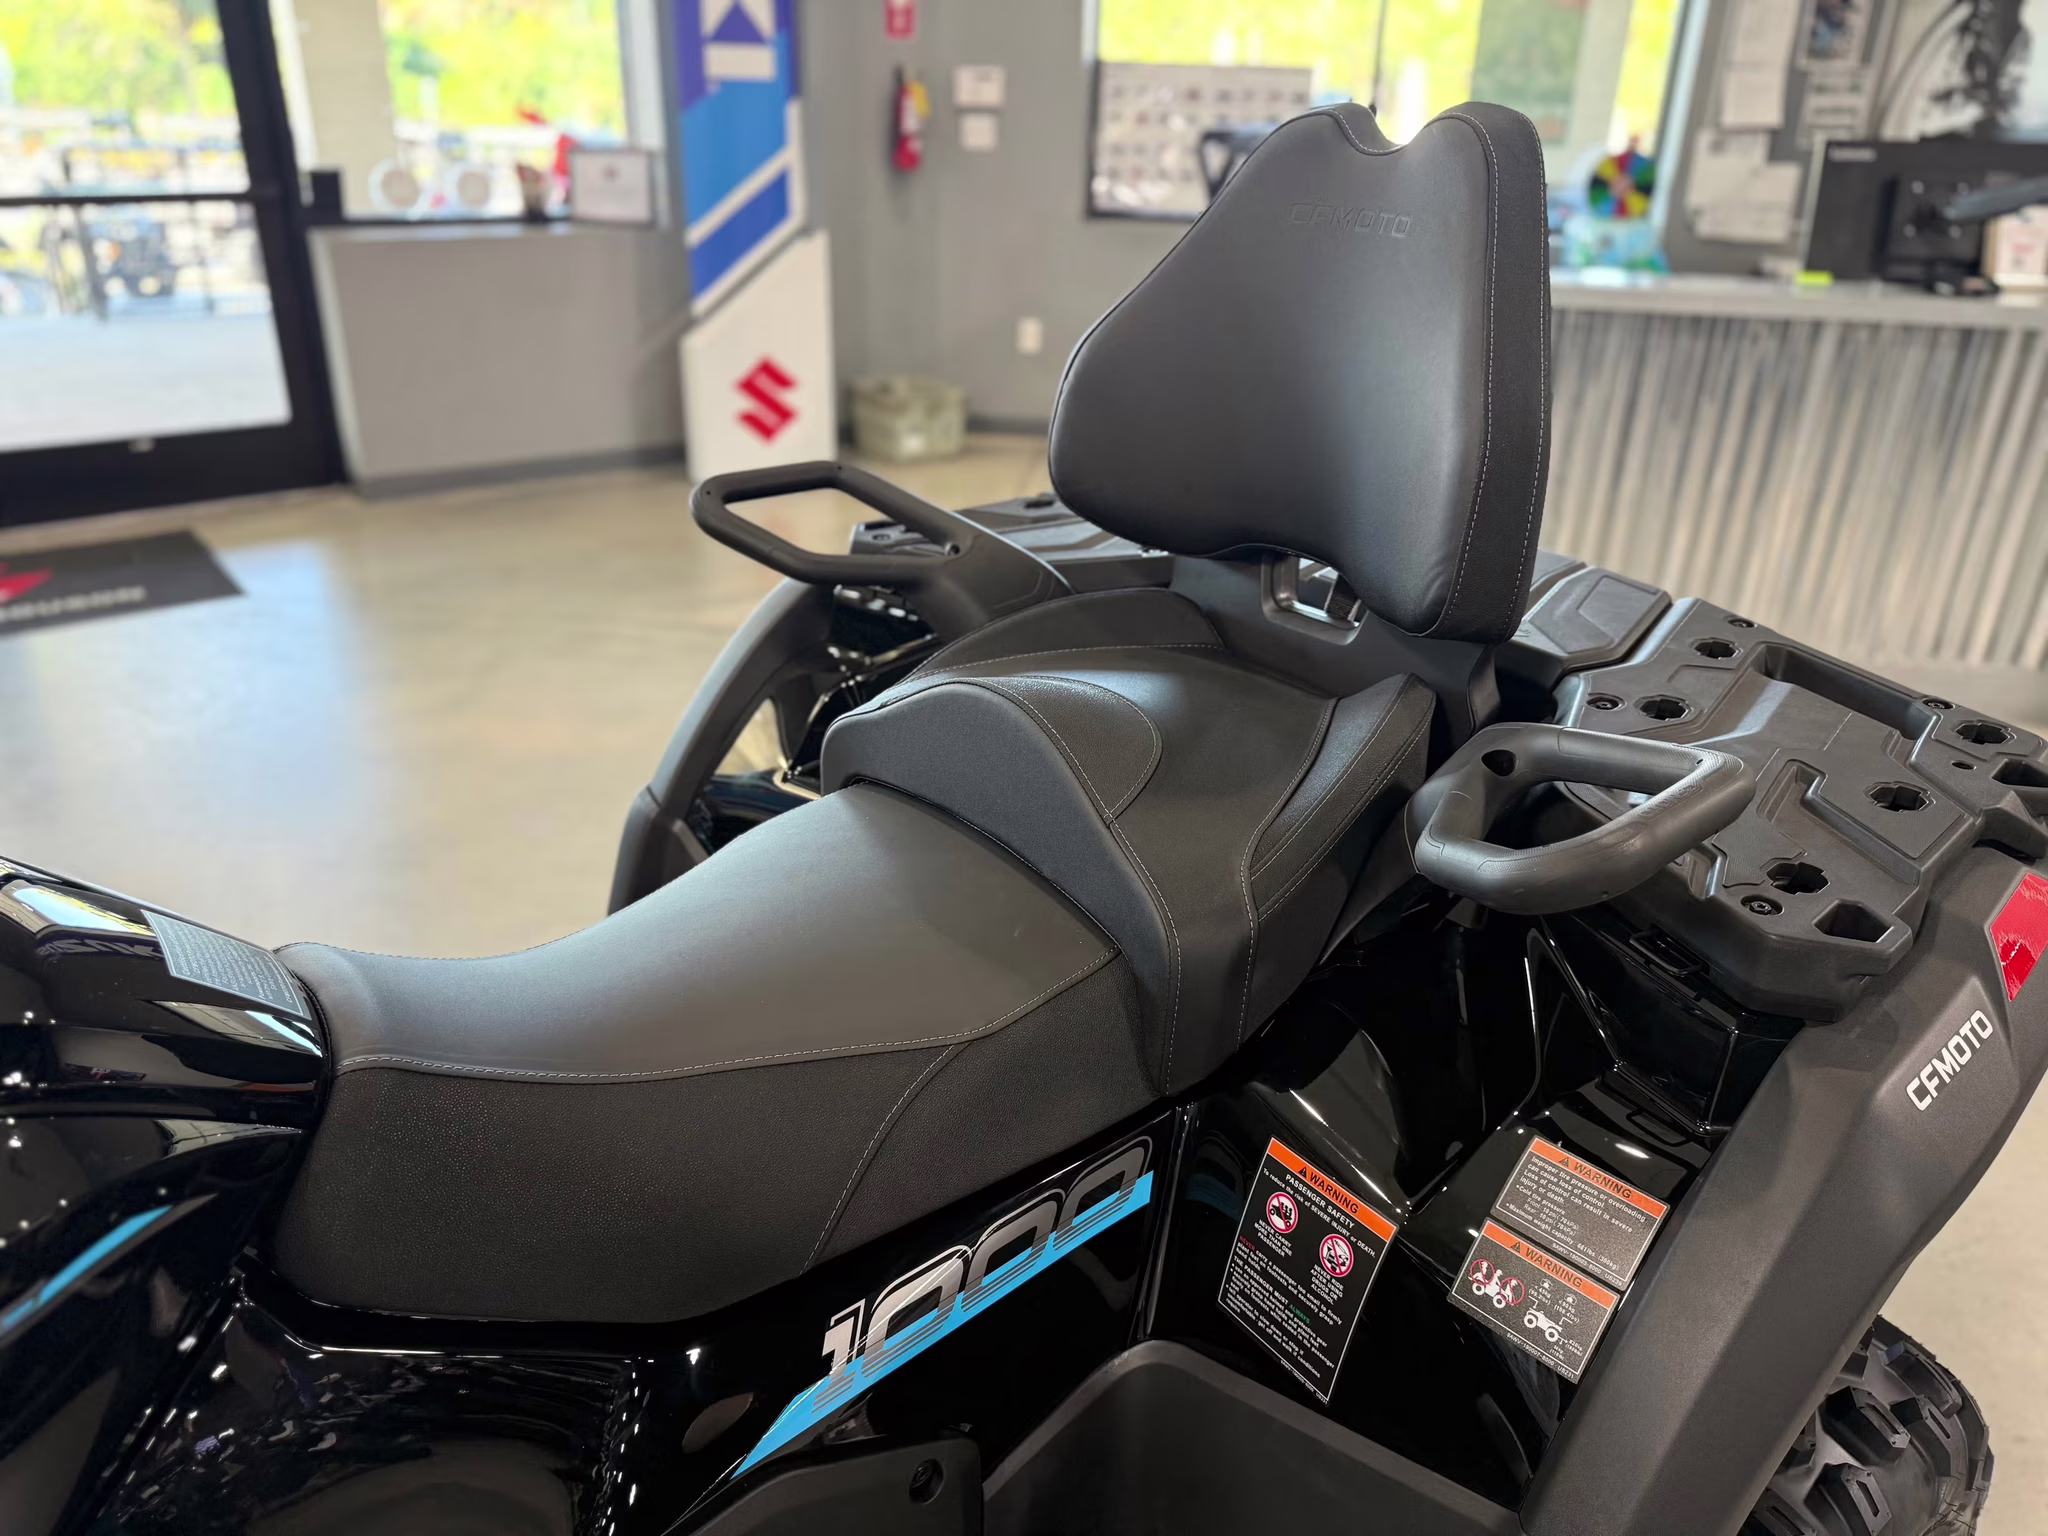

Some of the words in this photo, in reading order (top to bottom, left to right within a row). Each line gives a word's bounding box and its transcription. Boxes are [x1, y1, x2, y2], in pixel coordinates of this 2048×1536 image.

[1290, 202, 1410, 238] CFMOTO
[1906, 1009, 1994, 1111] CFMOTO
[1309, 1172, 1359, 1214] WARNING
[1519, 1176, 1538, 1190] injury
[1527, 1164, 1539, 1172] can
[1540, 1170, 1558, 1182] cause
[1559, 1180, 1573, 1190] loss
[1573, 1187, 1582, 1195] of
[1531, 1156, 1559, 1175] Improper
[1559, 1171, 1571, 1181] tire
[1570, 1178, 1599, 1197] pressure
[1599, 1192, 1608, 1200] or
[1607, 1198, 1646, 1223] overloading
[1573, 1163, 1633, 1198] WARNING
[1263, 1167, 1269, 1176] To
[1270, 1172, 1286, 1188] reduce
[1286, 1184, 1294, 1195] the
[1294, 1191, 1304, 1203] risk
[1304, 1199, 1311, 1207] of
[1311, 1204, 1331, 1223] SEVERE
[1331, 1219, 1350, 1237] INJURY
[1350, 1234, 1358, 1243] or
[1286, 1174, 1326, 1208] PASSENGER
[1327, 1204, 1355, 1229] SAFETY
[1519, 1186, 1532, 1196] Cold
[1531, 1193, 1542, 1201] tire
[1541, 1200, 1565, 1216] pressure
[1523, 1169, 1539, 1181] Loss
[1547, 1182, 1570, 1197] control
[1570, 1195, 1583, 1205] can
[1583, 1202, 1602, 1215] result
[1611, 1218, 1633, 1232] severe
[1254, 1222, 1267, 1236] MORE
[1268, 1234, 1281, 1247] THAN
[1281, 1245, 1292, 1256] ONE
[1258, 1232, 1285, 1257] PASSENGER
[1259, 1219, 1274, 1235] NEVER
[1275, 1232, 1291, 1248] CARRY
[820, 1135, 1154, 1416] 1000
[1311, 1269, 1327, 1285] AFTER
[1327, 1282, 1343, 1298] USING
[1314, 1264, 1331, 1281] NEVER
[1331, 1278, 1344, 1291] RIDE
[1524, 1248, 1584, 1288] WARNING
[1234, 1256, 1244, 1267] THE
[1244, 1265, 1273, 1292] PASSENGER
[1274, 1290, 1288, 1306] MUST
[1289, 1303, 1310, 1324] ALWAYS
[1311, 1283, 1335, 1305] ALCOHOL
[1312, 1276, 1329, 1294] DRUGS
[1329, 1291, 1338, 1301] OR
